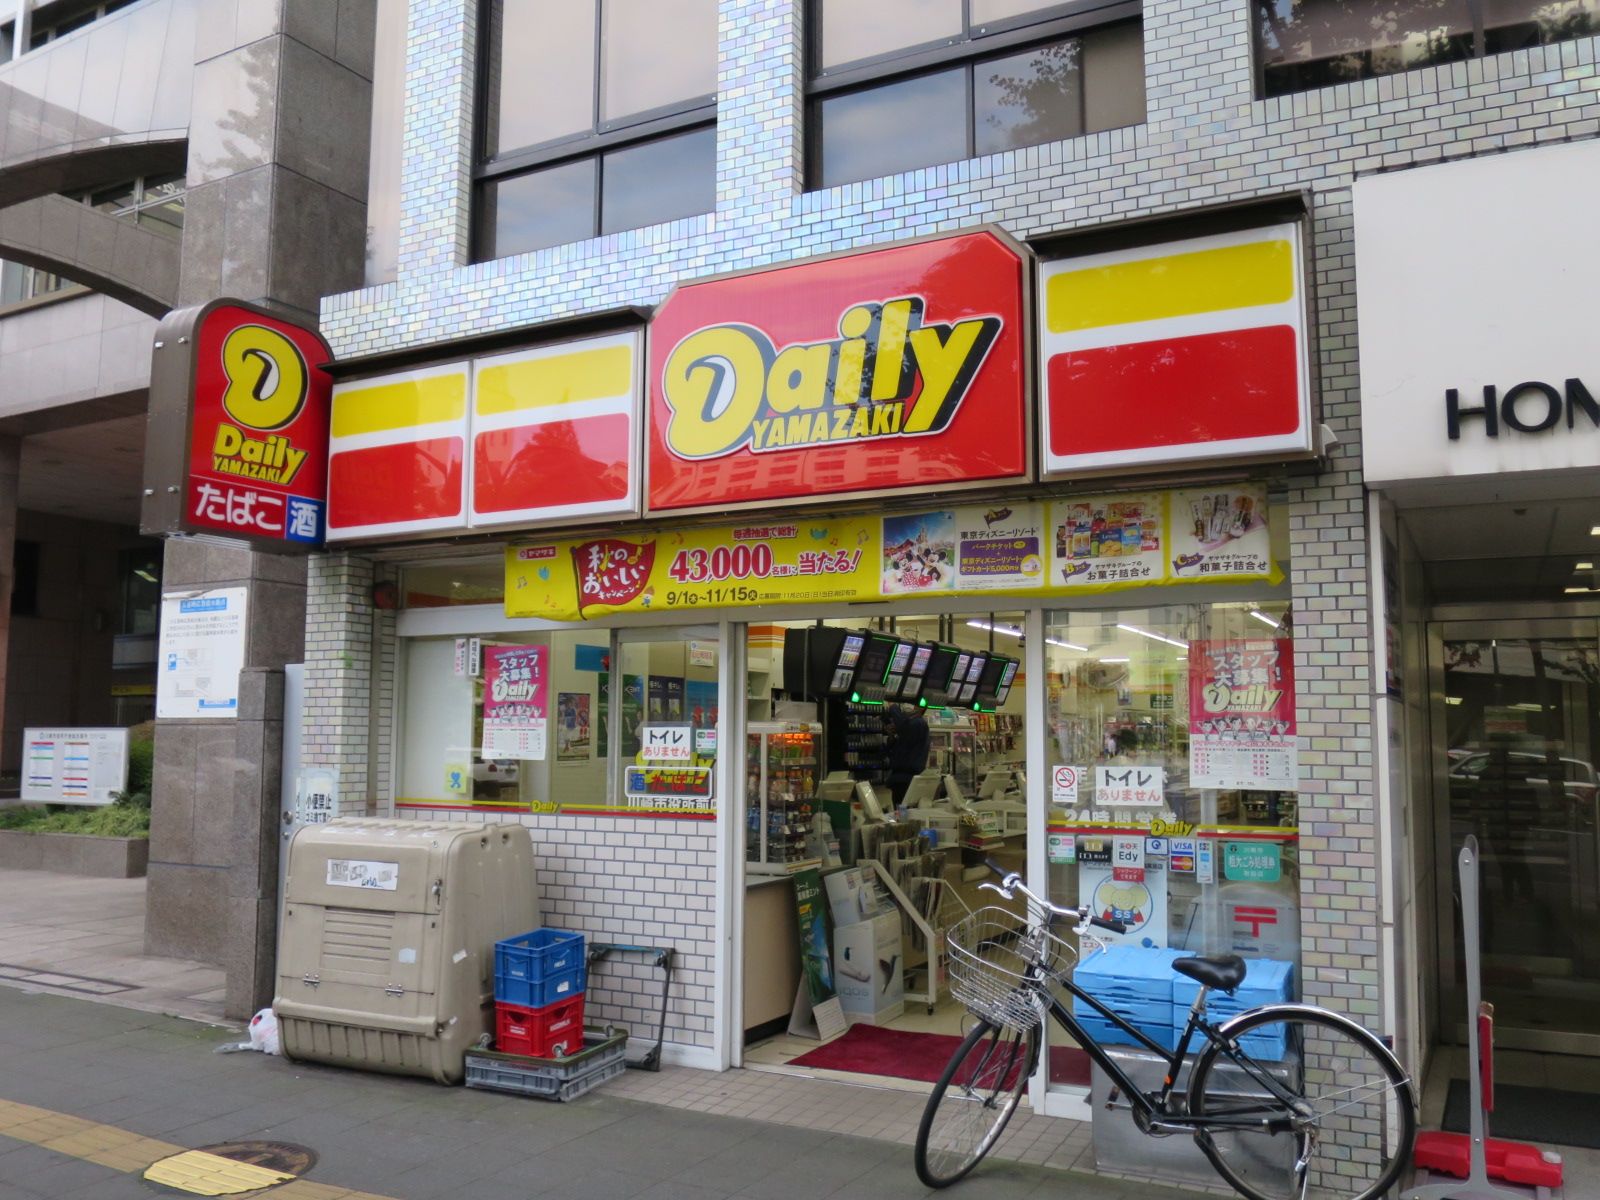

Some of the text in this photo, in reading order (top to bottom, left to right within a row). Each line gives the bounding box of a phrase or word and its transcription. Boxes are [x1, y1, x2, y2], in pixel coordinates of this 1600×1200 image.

[664, 296, 1001, 458] Daily
[752, 403, 903, 449] YAMAZAKI
[214, 422, 309, 485] Daily
[213, 456, 281, 483] YAMAZAKI
[194, 483, 283, 532] たばこ
[288, 501, 318, 539] 酒
[960, 528, 1036, 540] 東京ディズニーリゾート
[971, 542, 1012, 550] パークチケット
[588, 544, 628, 573] 秋の
[669, 543, 773, 583] 43,000
[1208, 554, 1258, 562] ヤマザキグループの
[1087, 567, 1151, 581] お菓子詰合せ
[1199, 561, 1268, 573] 和菓子詰合せ
[583, 565, 647, 594] おいしい
[598, 586, 636, 600] キャンペーン
[499, 654, 539, 671] スタッフ
[1214, 650, 1280, 670] スタッフ
[492, 678, 541, 702] Daily
[1203, 683, 1283, 713] Daily
[649, 730, 684, 744] トイレ
[643, 747, 690, 757] ありません
[631, 773, 645, 790] 酒
[651, 772, 707, 792] たばこ
[1105, 769, 1153, 786] トイレ
[306, 793, 332, 810] 小便禁止
[1096, 789, 1162, 803] ありません
[531, 799, 560, 813] Daily
[1150, 818, 1194, 837] Daily
[1174, 842, 1193, 850] VISA
[1119, 851, 1139, 862] Edy
[1114, 909, 1132, 919] SS
